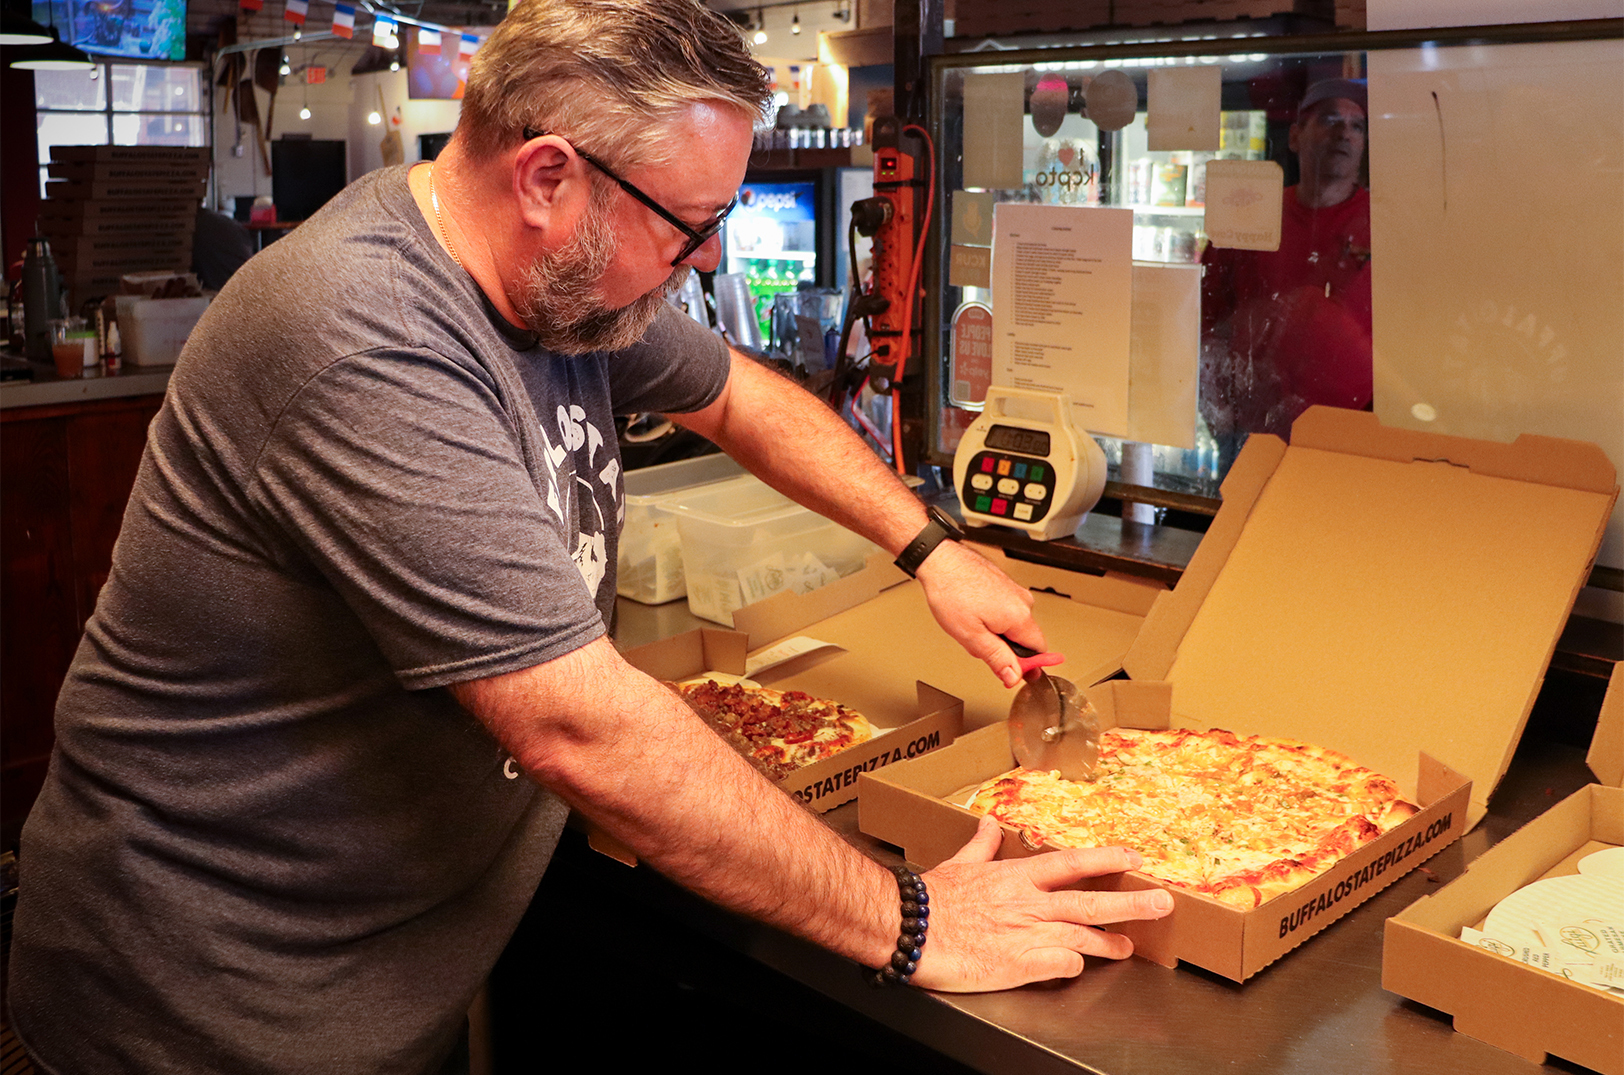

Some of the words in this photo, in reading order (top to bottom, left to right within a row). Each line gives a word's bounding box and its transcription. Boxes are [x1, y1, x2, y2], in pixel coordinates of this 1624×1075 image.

[757, 191, 797, 213] pepsi
[1278, 812, 1453, 939] BUFFALOSTATEPIZZA.COM
[1600, 929, 1619, 953] GRATED
